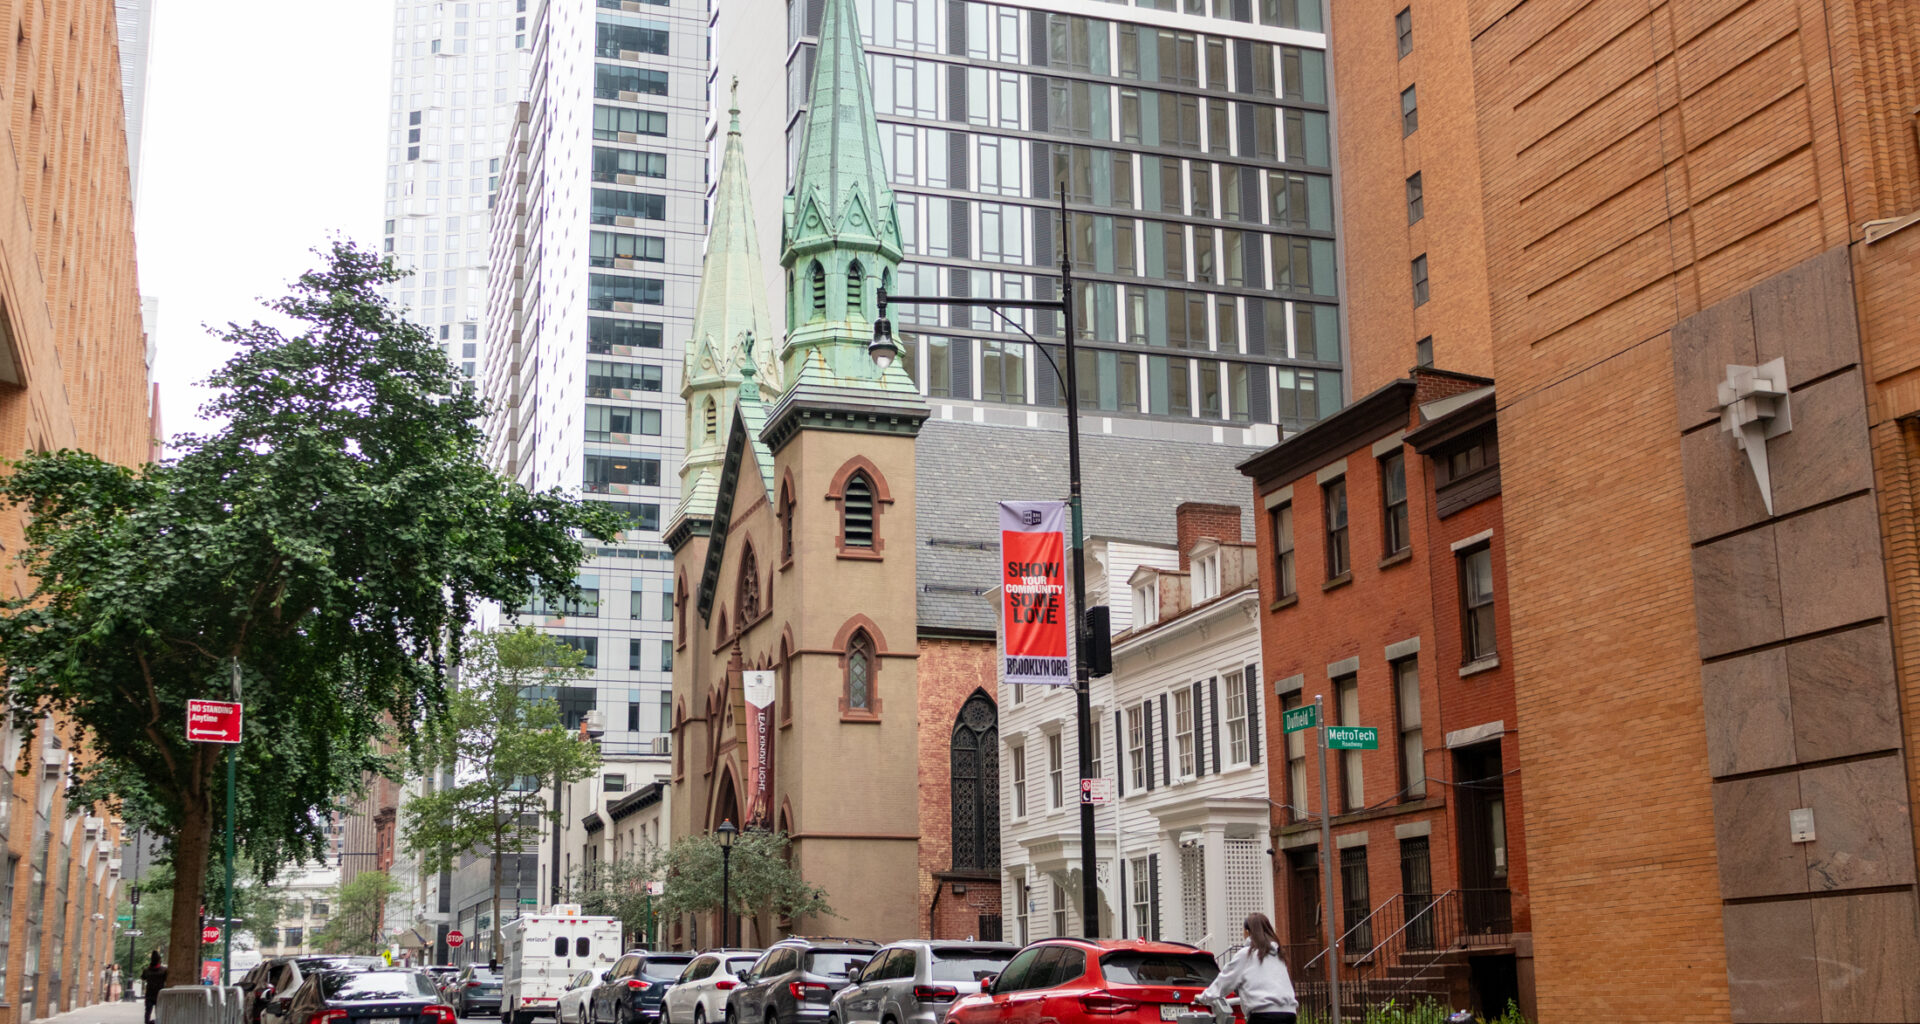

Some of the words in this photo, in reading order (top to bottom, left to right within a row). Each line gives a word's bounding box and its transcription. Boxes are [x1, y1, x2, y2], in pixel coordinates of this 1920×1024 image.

[1008, 562, 1059, 577] SHOW
[1021, 576, 1047, 585] YOUR
[1006, 584, 1063, 594] COMMUNITY
[1010, 593, 1059, 608] SOME
[1013, 608, 1058, 624] LOVE
[1006, 658, 1050, 676] BROOKLYN
[1051, 659, 1068, 676] ORG
[191, 704, 201, 712] NO
[202, 705, 233, 714] STANDING
[192, 713, 218, 723] Anytime
[758, 712, 766, 734] LEAD
[1286, 709, 1308, 730] Duffield
[1329, 729, 1375, 741] MetroTech
[203, 930, 219, 938] STOP
[447, 934, 464, 943] STOP
